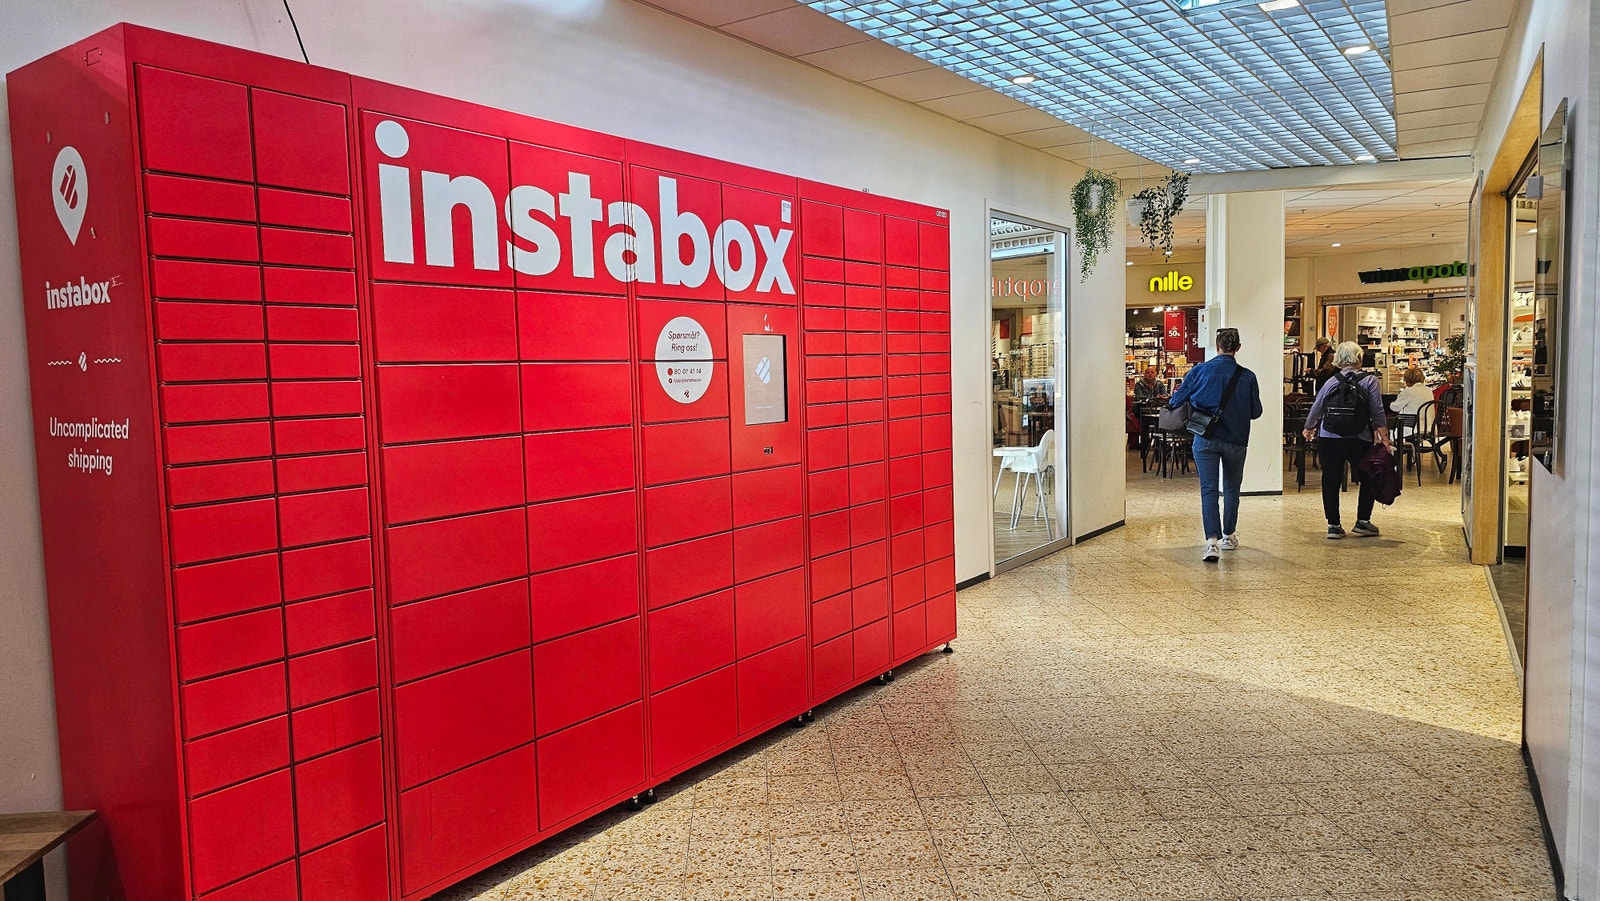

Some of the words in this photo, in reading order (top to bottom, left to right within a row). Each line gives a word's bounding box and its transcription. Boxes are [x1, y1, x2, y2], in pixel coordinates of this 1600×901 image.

[374, 120, 796, 295] instabox
[46, 275, 112, 310] instabox
[1149, 270, 1194, 293] nille
[667, 330, 701, 342] Spørsmål?
[671, 343, 685, 354] Ring
[686, 343, 698, 352] oss!
[49, 416, 130, 443] Uncomplicated
[68, 447, 113, 476] shipping
